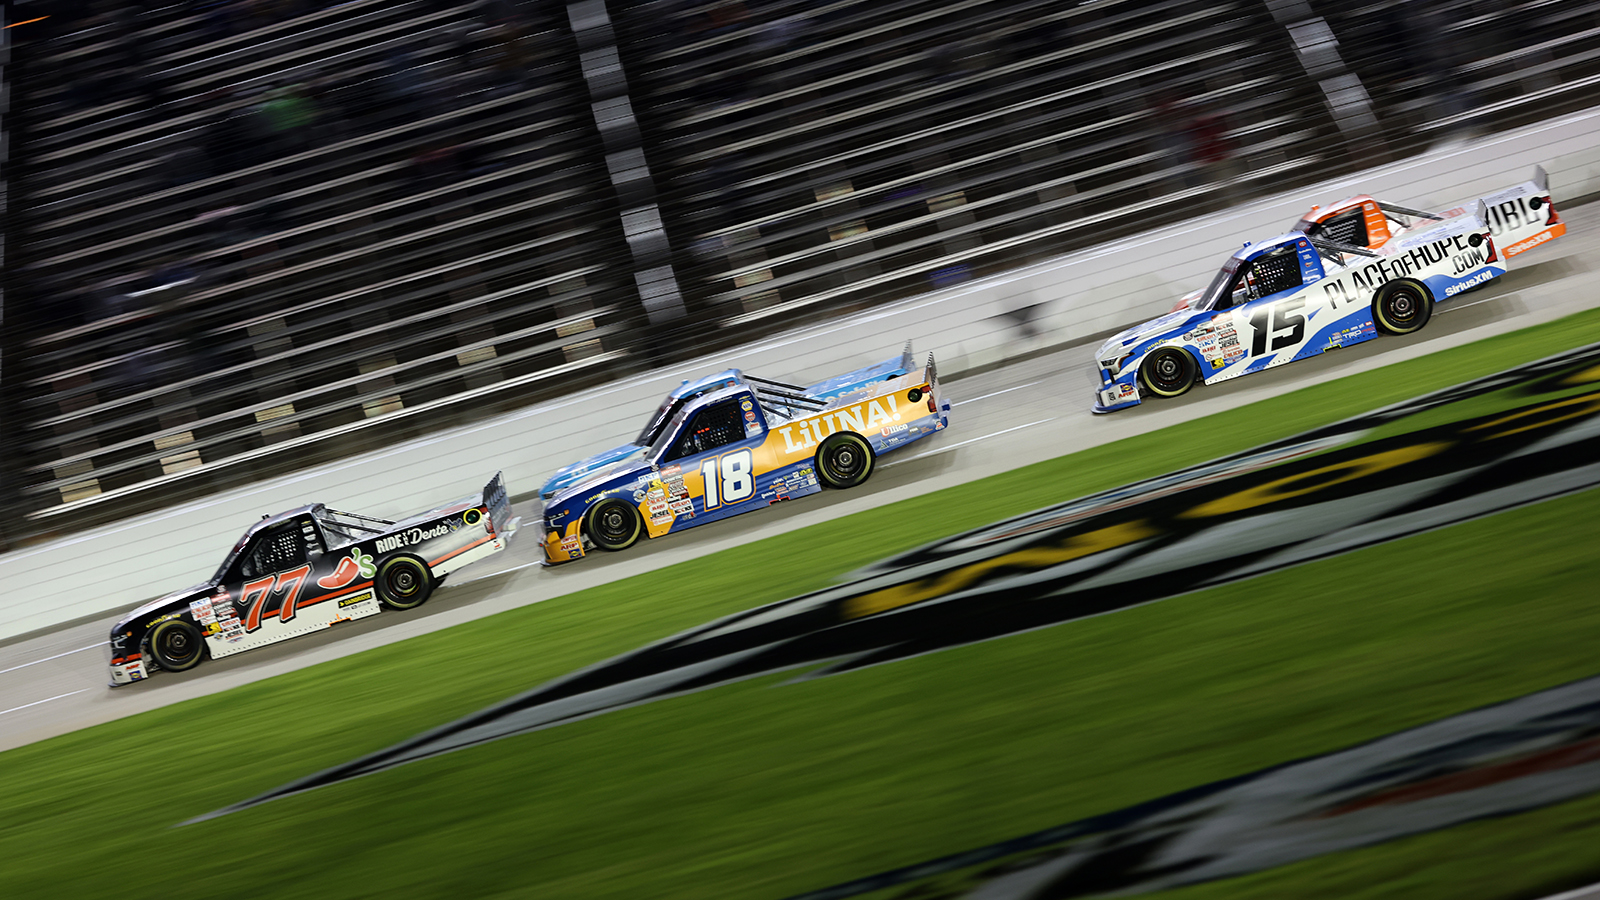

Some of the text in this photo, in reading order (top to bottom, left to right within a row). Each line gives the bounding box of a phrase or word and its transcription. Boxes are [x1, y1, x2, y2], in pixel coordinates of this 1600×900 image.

[1506, 230, 1553, 256] SiriusXM
[1444, 270, 1494, 296] SiriusXM
[1249, 296, 1307, 357] 15
[779, 395, 902, 455] LiUNA!
[880, 423, 909, 438] Ullico
[701, 448, 755, 509] 18
[375, 532, 404, 554] RIDE
[560, 542, 578, 551] ARP
[239, 562, 313, 633] 77
